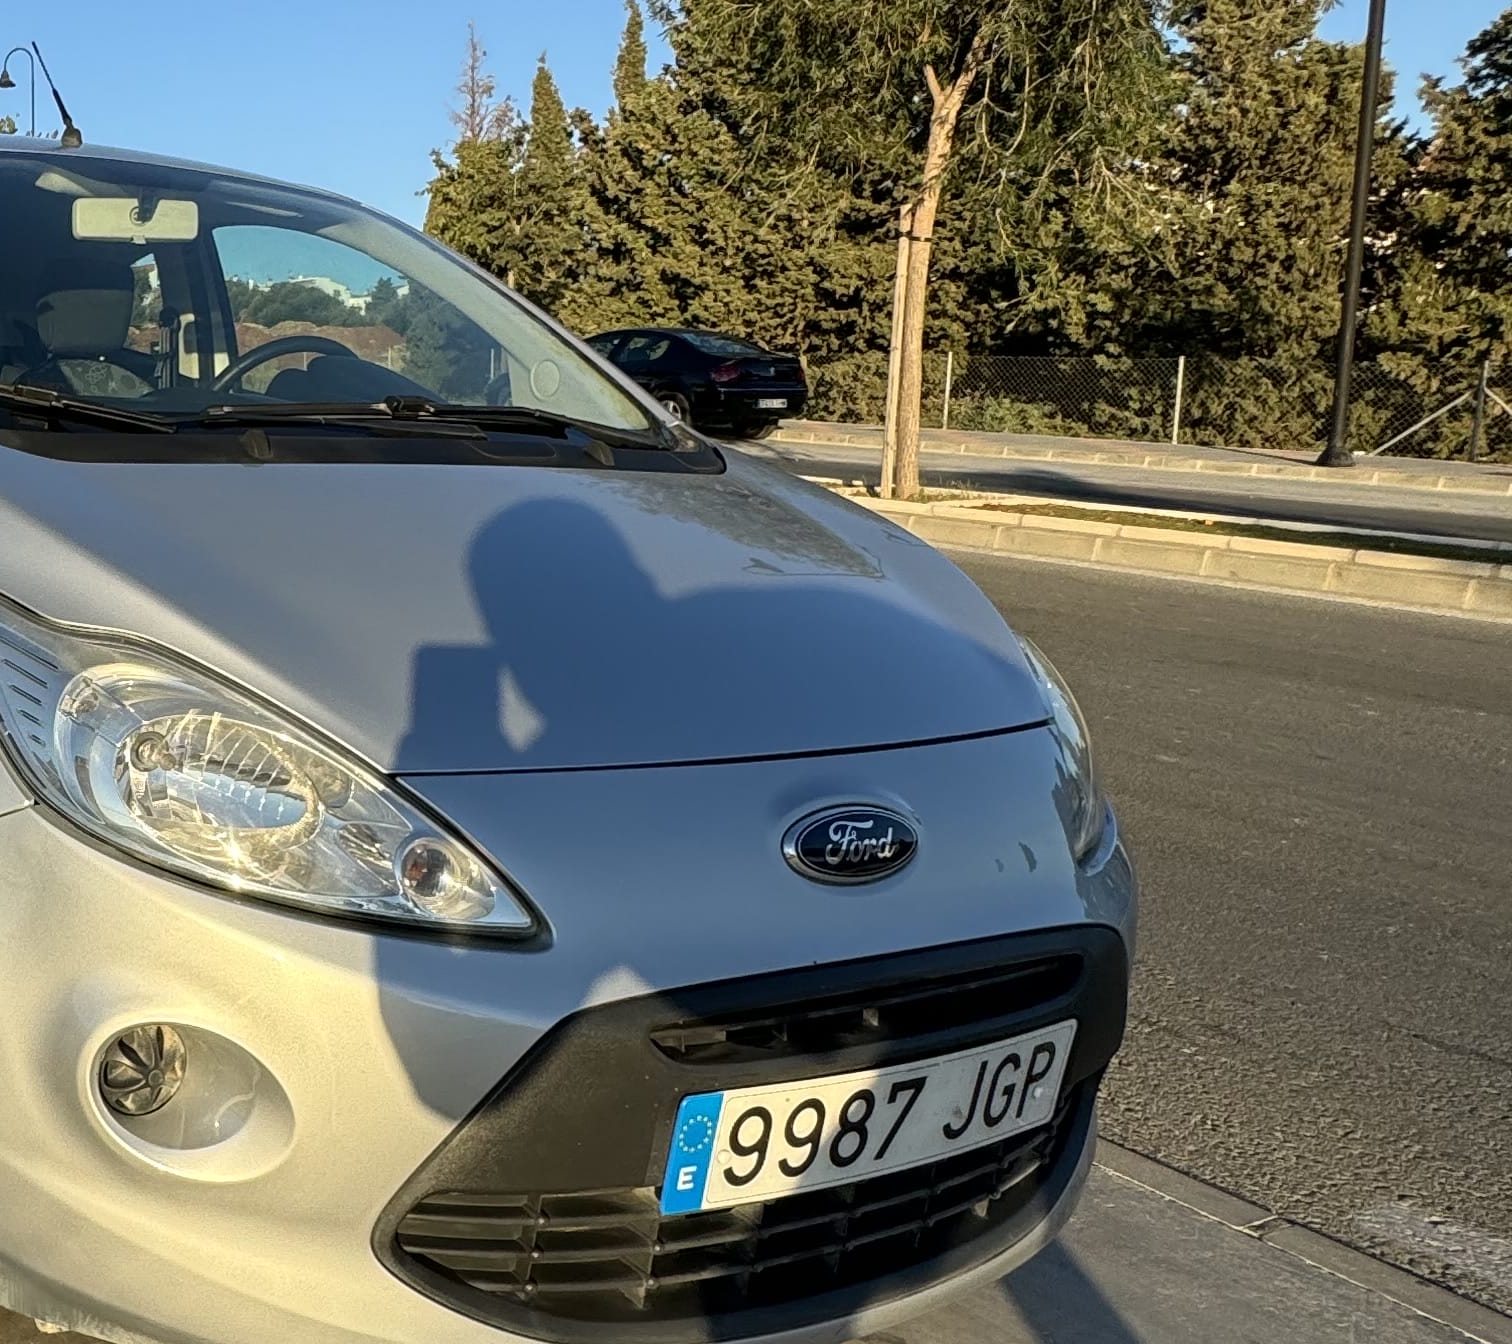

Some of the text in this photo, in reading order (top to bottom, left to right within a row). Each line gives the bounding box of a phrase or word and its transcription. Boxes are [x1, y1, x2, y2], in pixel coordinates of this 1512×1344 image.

[825, 819, 899, 865] Ford
[722, 1040, 1057, 1187] 9987 JGP
[676, 1164, 697, 1191] E
